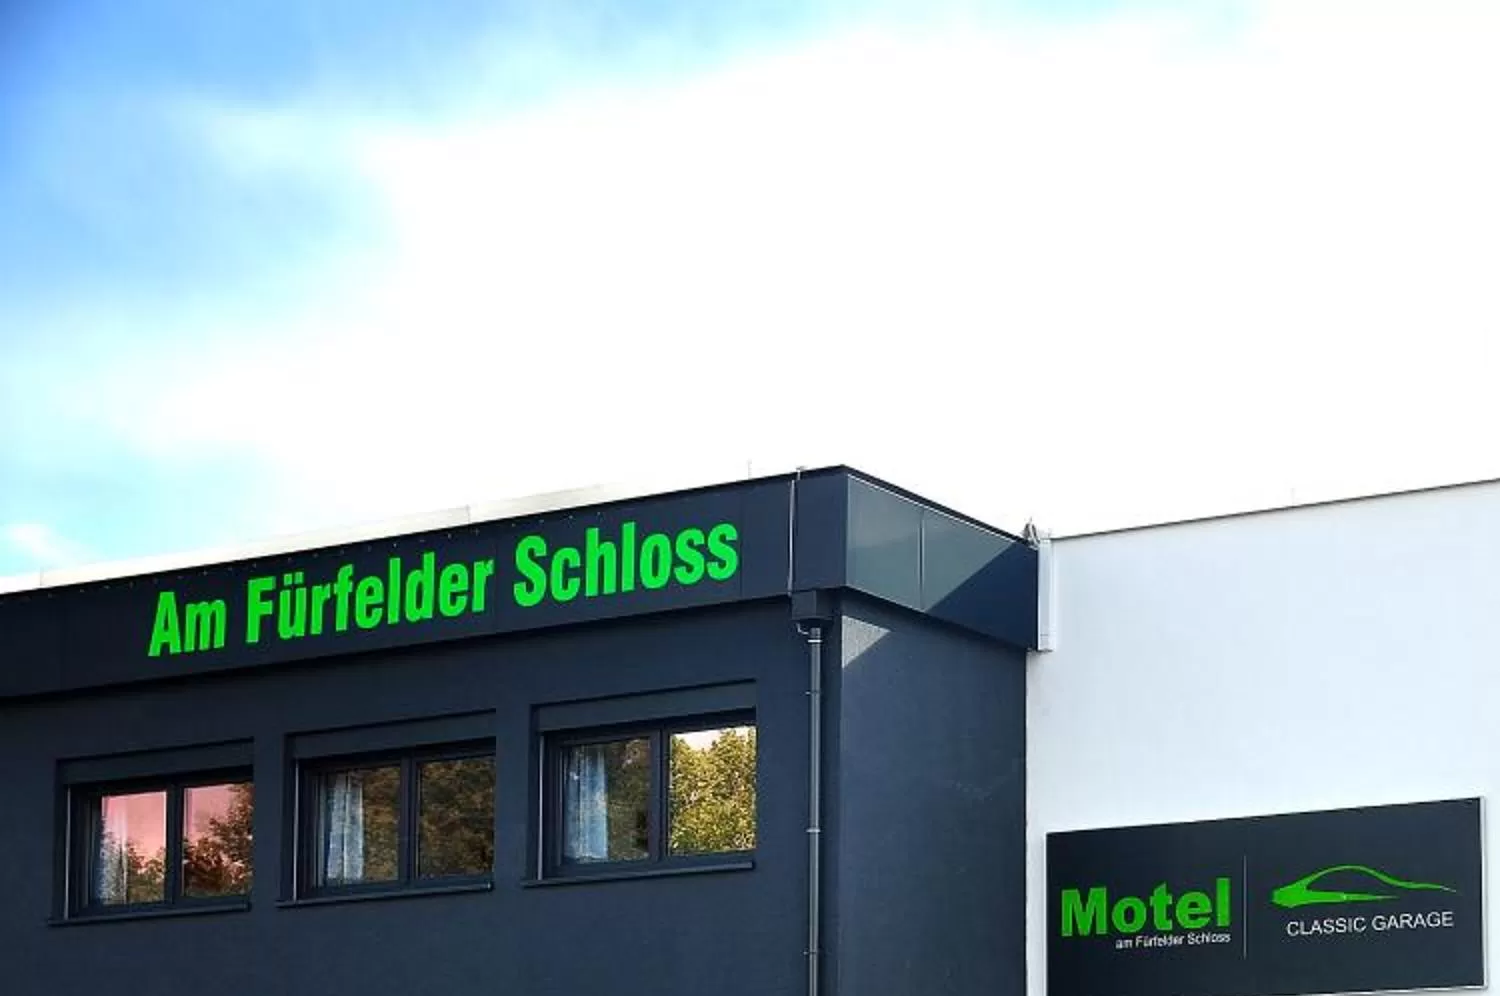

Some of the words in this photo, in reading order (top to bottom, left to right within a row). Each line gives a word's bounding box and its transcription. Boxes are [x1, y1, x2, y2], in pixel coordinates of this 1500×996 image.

[147, 590, 227, 658] Am
[245, 550, 496, 644] Fürfelder
[513, 522, 738, 608] Schloss
[1061, 877, 1231, 937] Motel
[1286, 917, 1367, 937] CLASSIC
[1371, 911, 1454, 931] GARAGE
[1115, 939, 1133, 949] am
[1135, 934, 1185, 948] Fürfelder
[1187, 932, 1231, 945] Schloss
